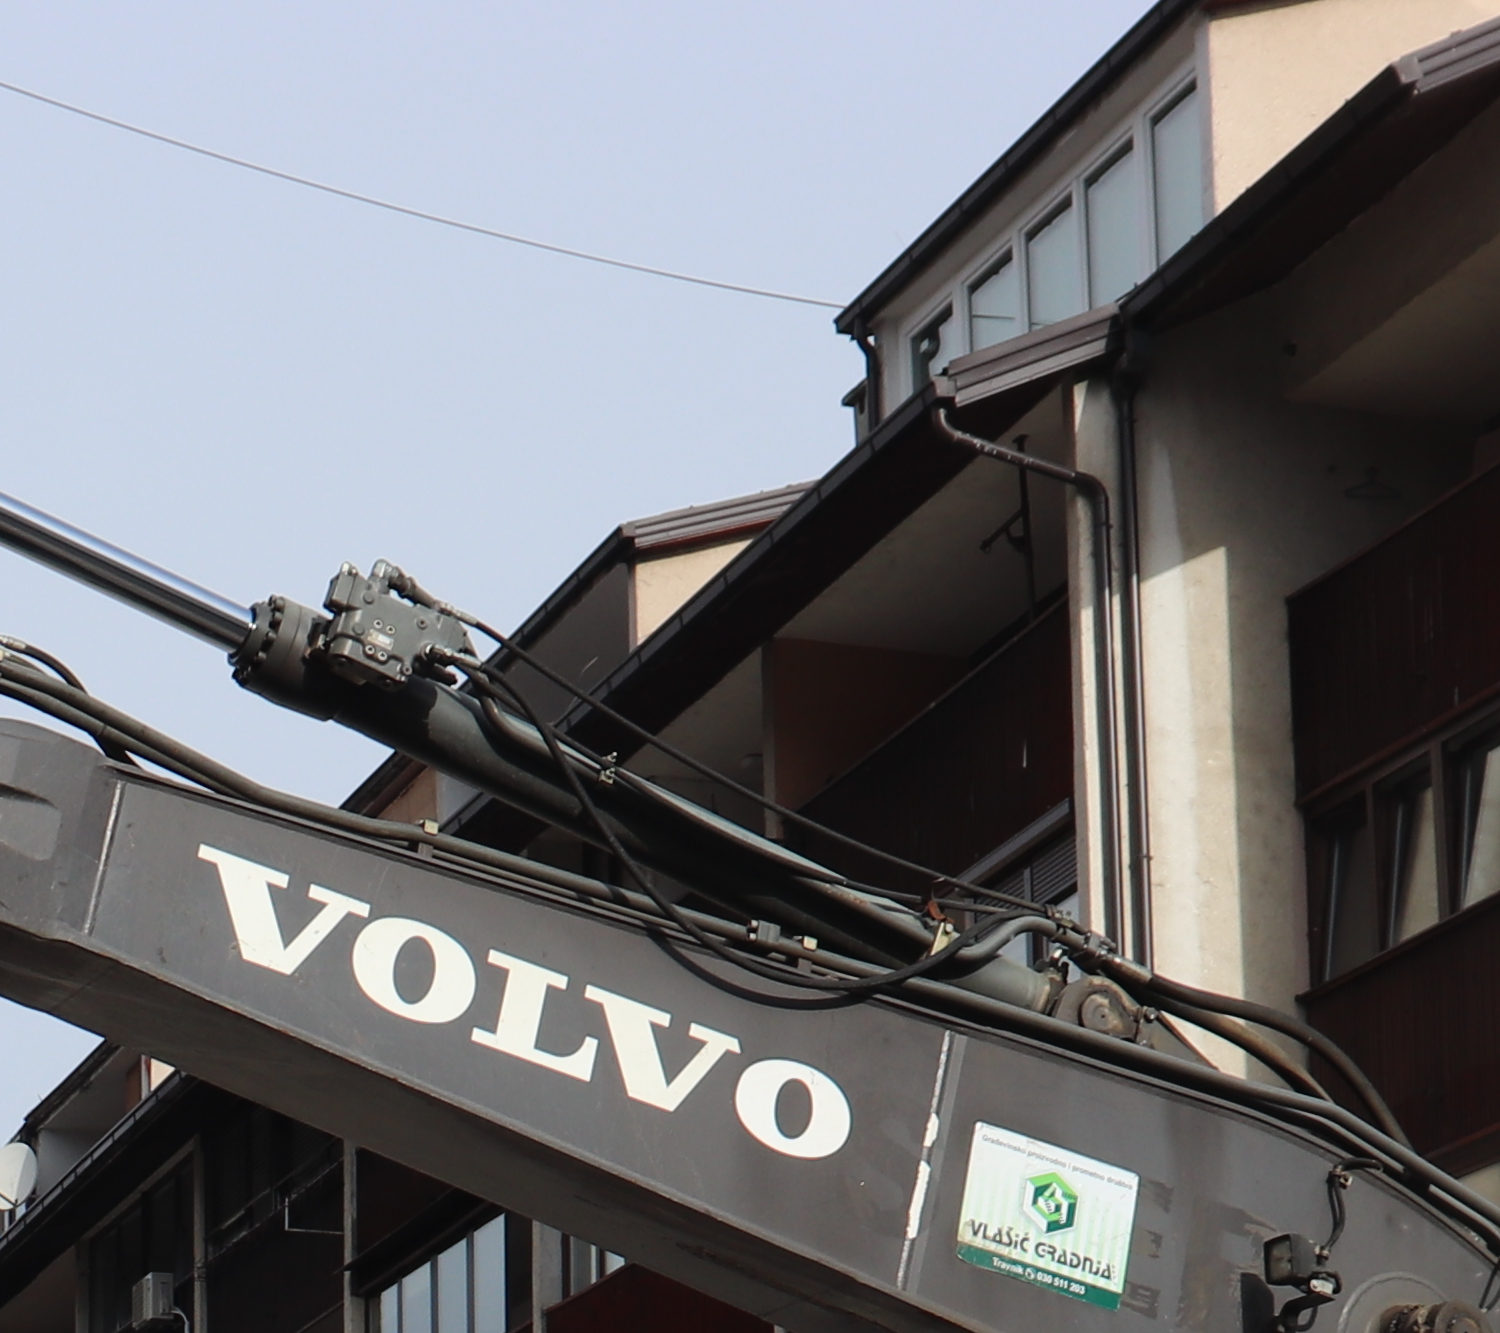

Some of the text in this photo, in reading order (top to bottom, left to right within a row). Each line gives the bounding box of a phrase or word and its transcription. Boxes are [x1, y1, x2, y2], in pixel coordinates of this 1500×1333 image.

[199, 843, 852, 1158] VOLVO
[992, 1256, 1024, 1275] Travnik
[1053, 1276, 1068, 1290] 511
